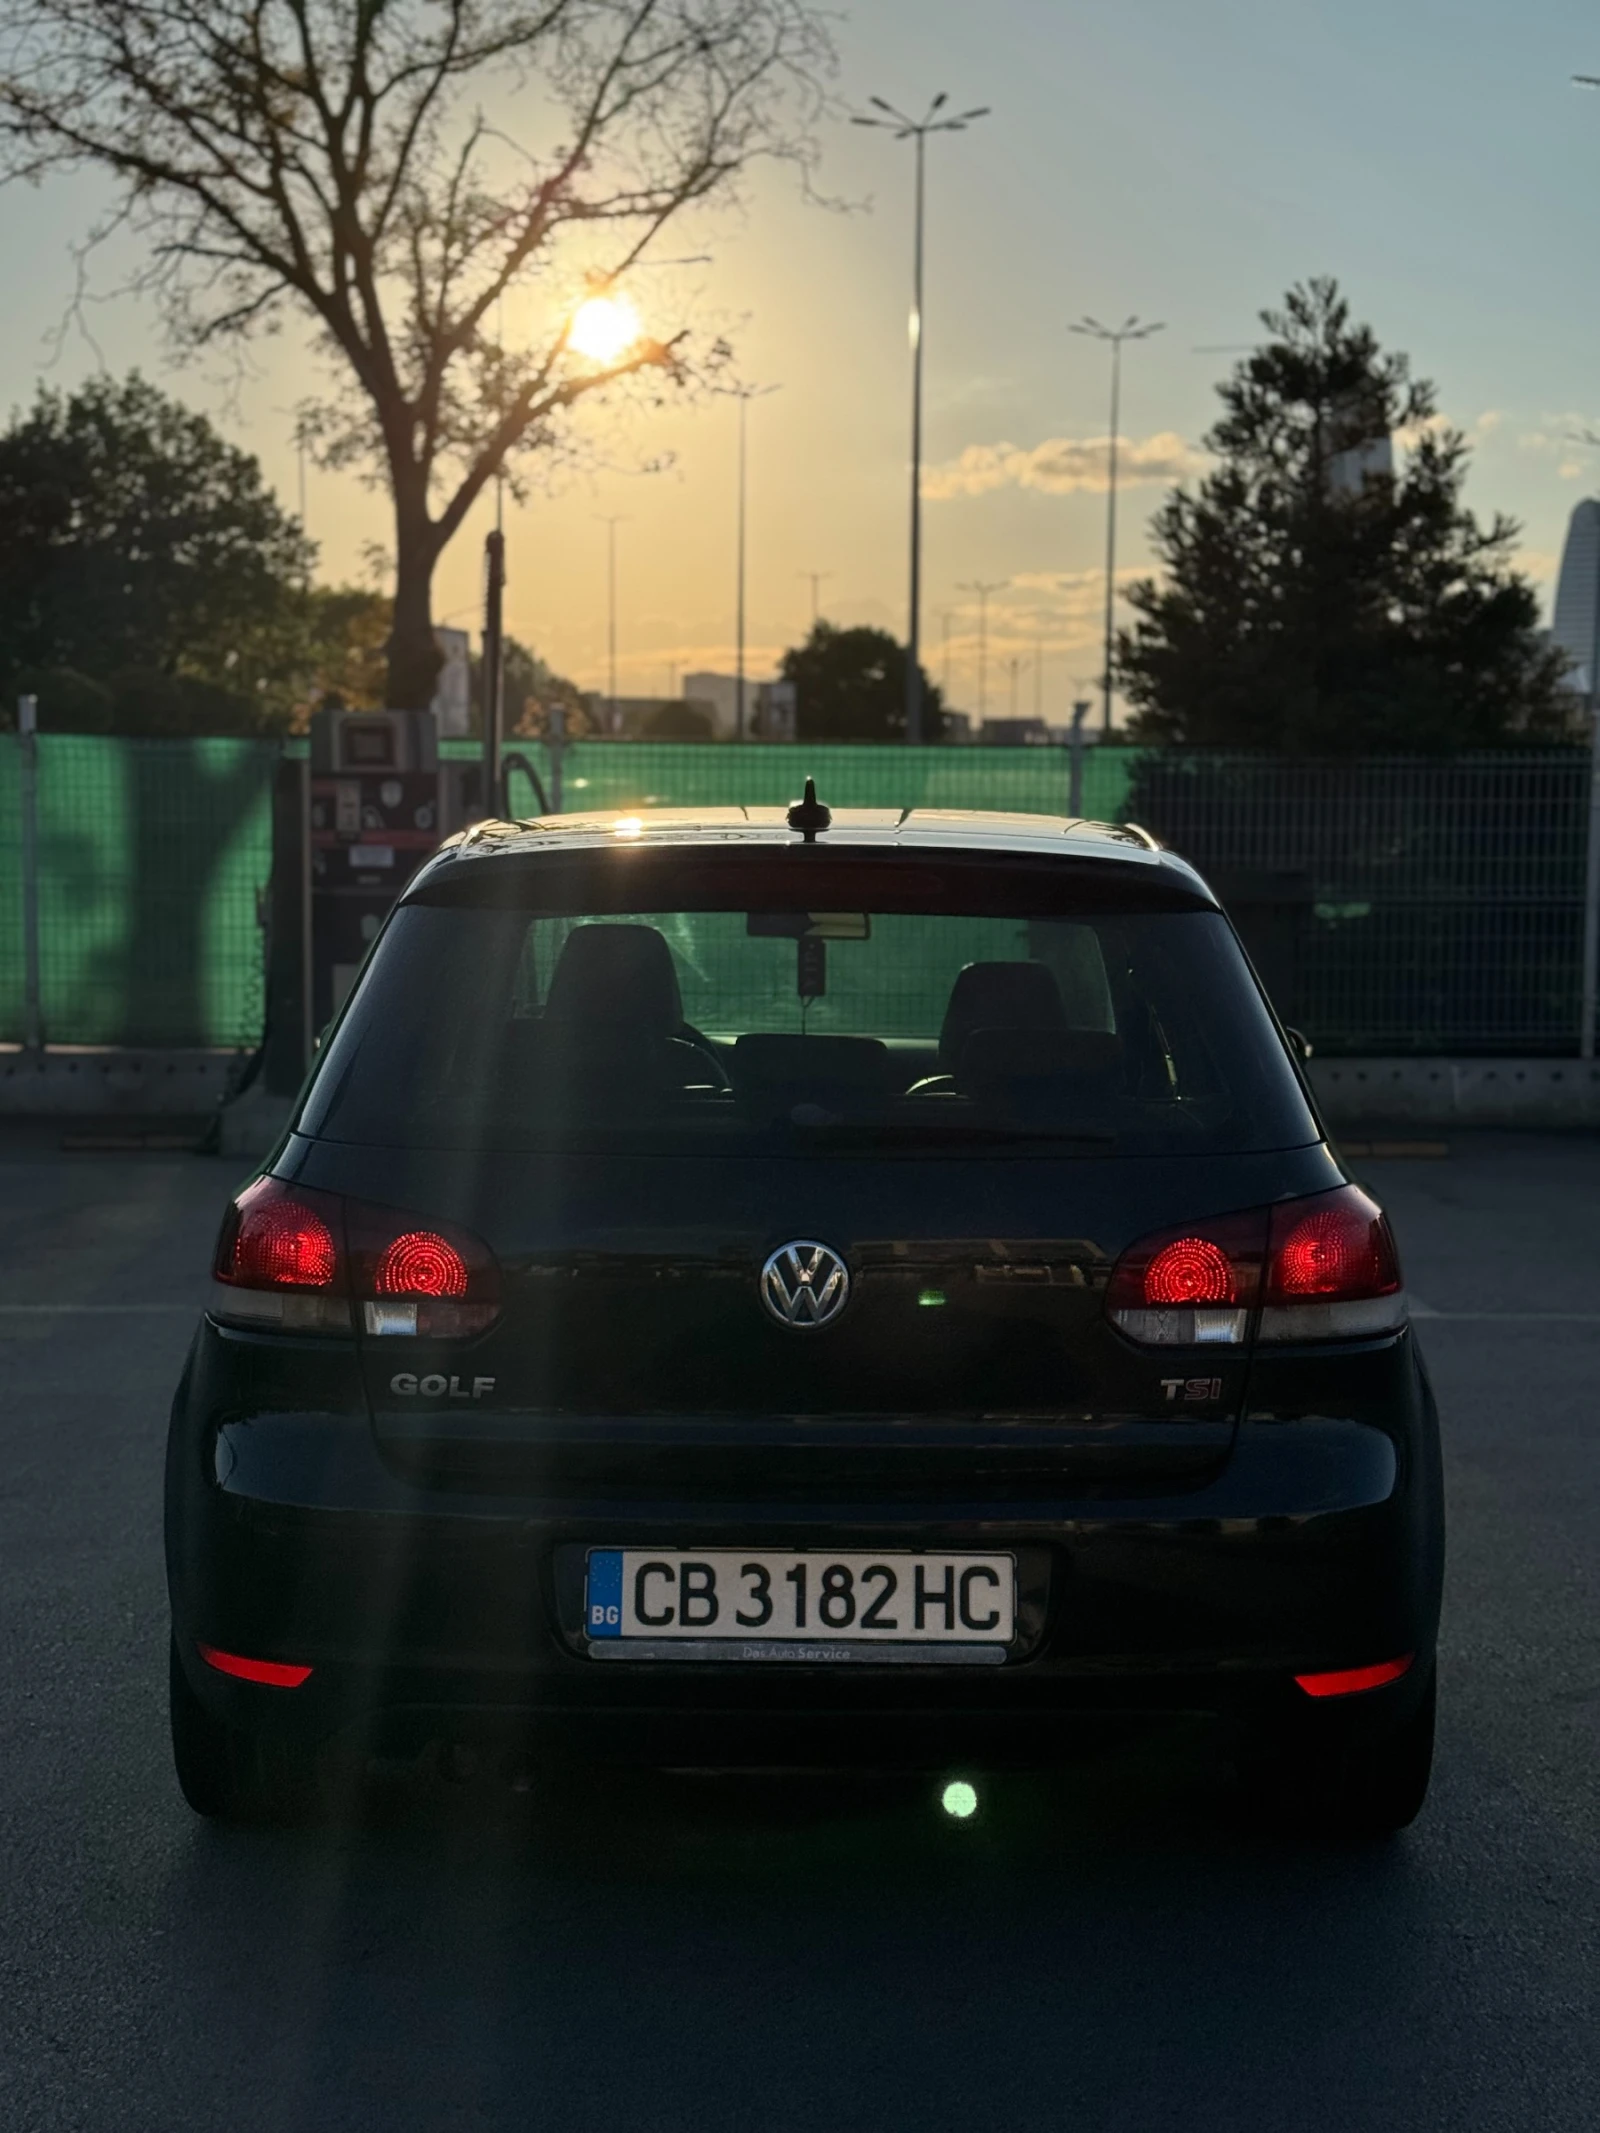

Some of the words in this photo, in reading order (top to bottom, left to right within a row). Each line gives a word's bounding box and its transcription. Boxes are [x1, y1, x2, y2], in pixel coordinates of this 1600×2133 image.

[762, 1241, 848, 1326] VW
[390, 1373, 496, 1399] GOLF
[1160, 1378, 1222, 1400] TSI
[634, 1562, 719, 1627] CB
[735, 1563, 898, 1630] 3182
[914, 1565, 1000, 1631] HC
[591, 1605, 619, 1625] BG
[768, 1647, 796, 1660] Auto
[798, 1646, 852, 1660] Service
